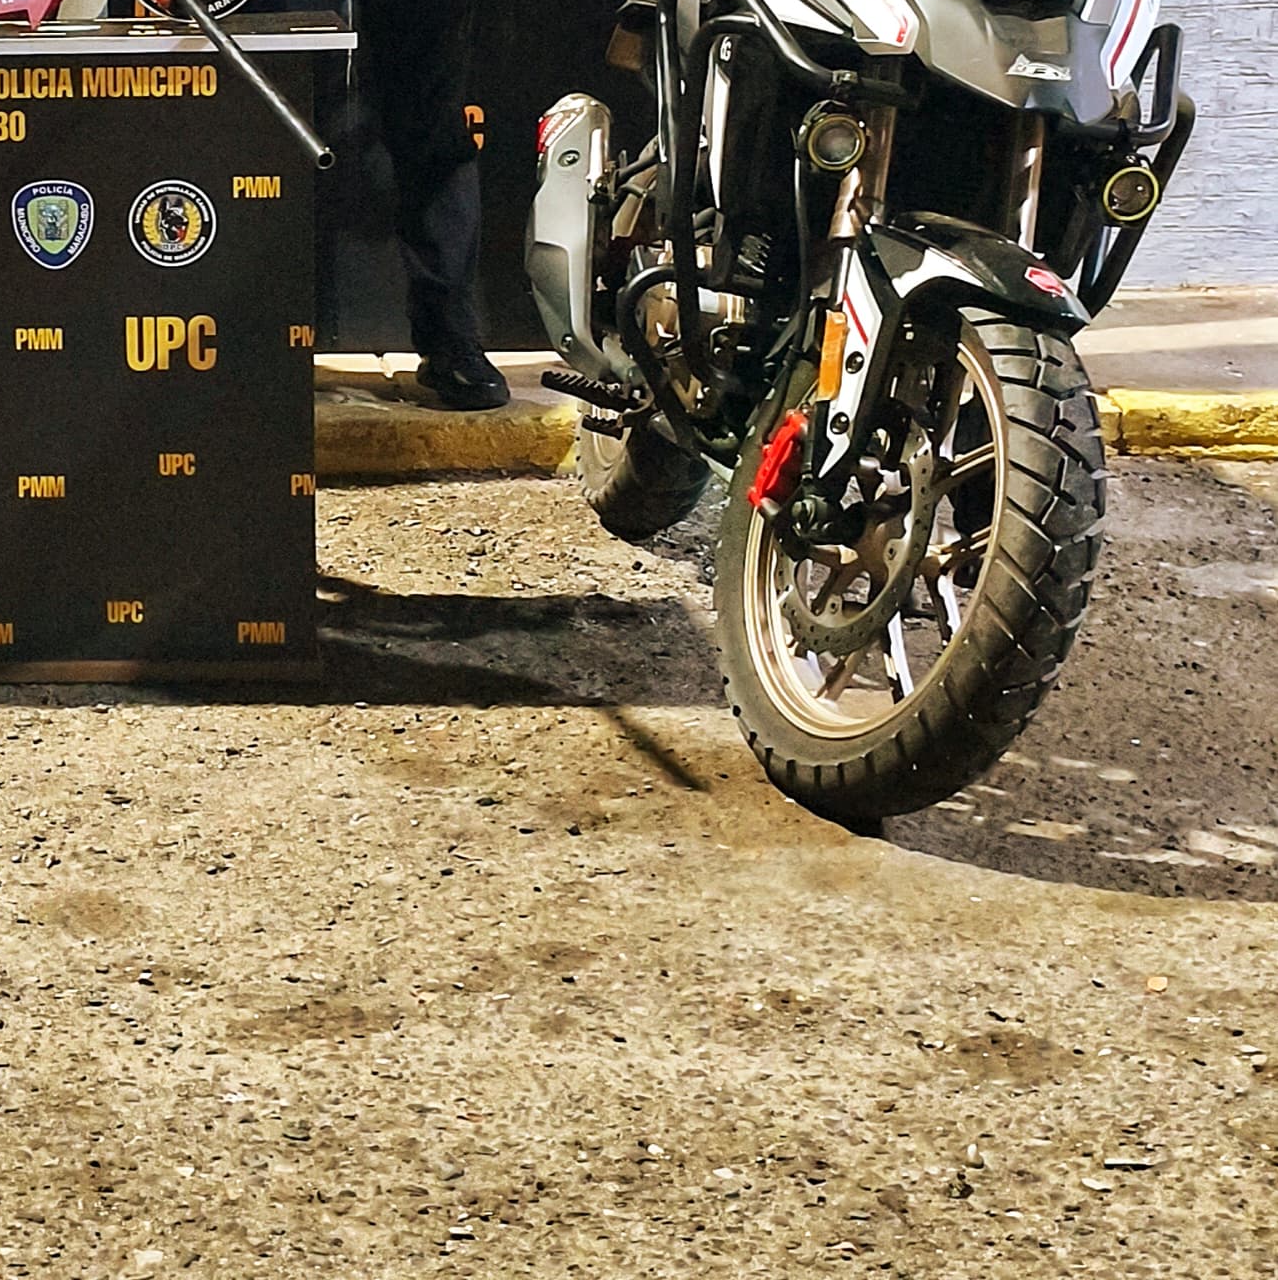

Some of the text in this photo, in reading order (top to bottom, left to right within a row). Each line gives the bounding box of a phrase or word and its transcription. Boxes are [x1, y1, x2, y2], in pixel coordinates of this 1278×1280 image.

[81, 65, 217, 98] MUNICIPIO
[32, 185, 74, 196] POLICÍA
[233, 176, 280, 198] PMM
[16, 328, 63, 350] PMM
[126, 315, 216, 371] UPC
[290, 326, 314, 346] PM
[159, 453, 195, 475] UPC
[18, 476, 65, 497] PMM
[291, 474, 315, 496] PM
[107, 601, 143, 623] UPC
[238, 622, 285, 644] PMM
